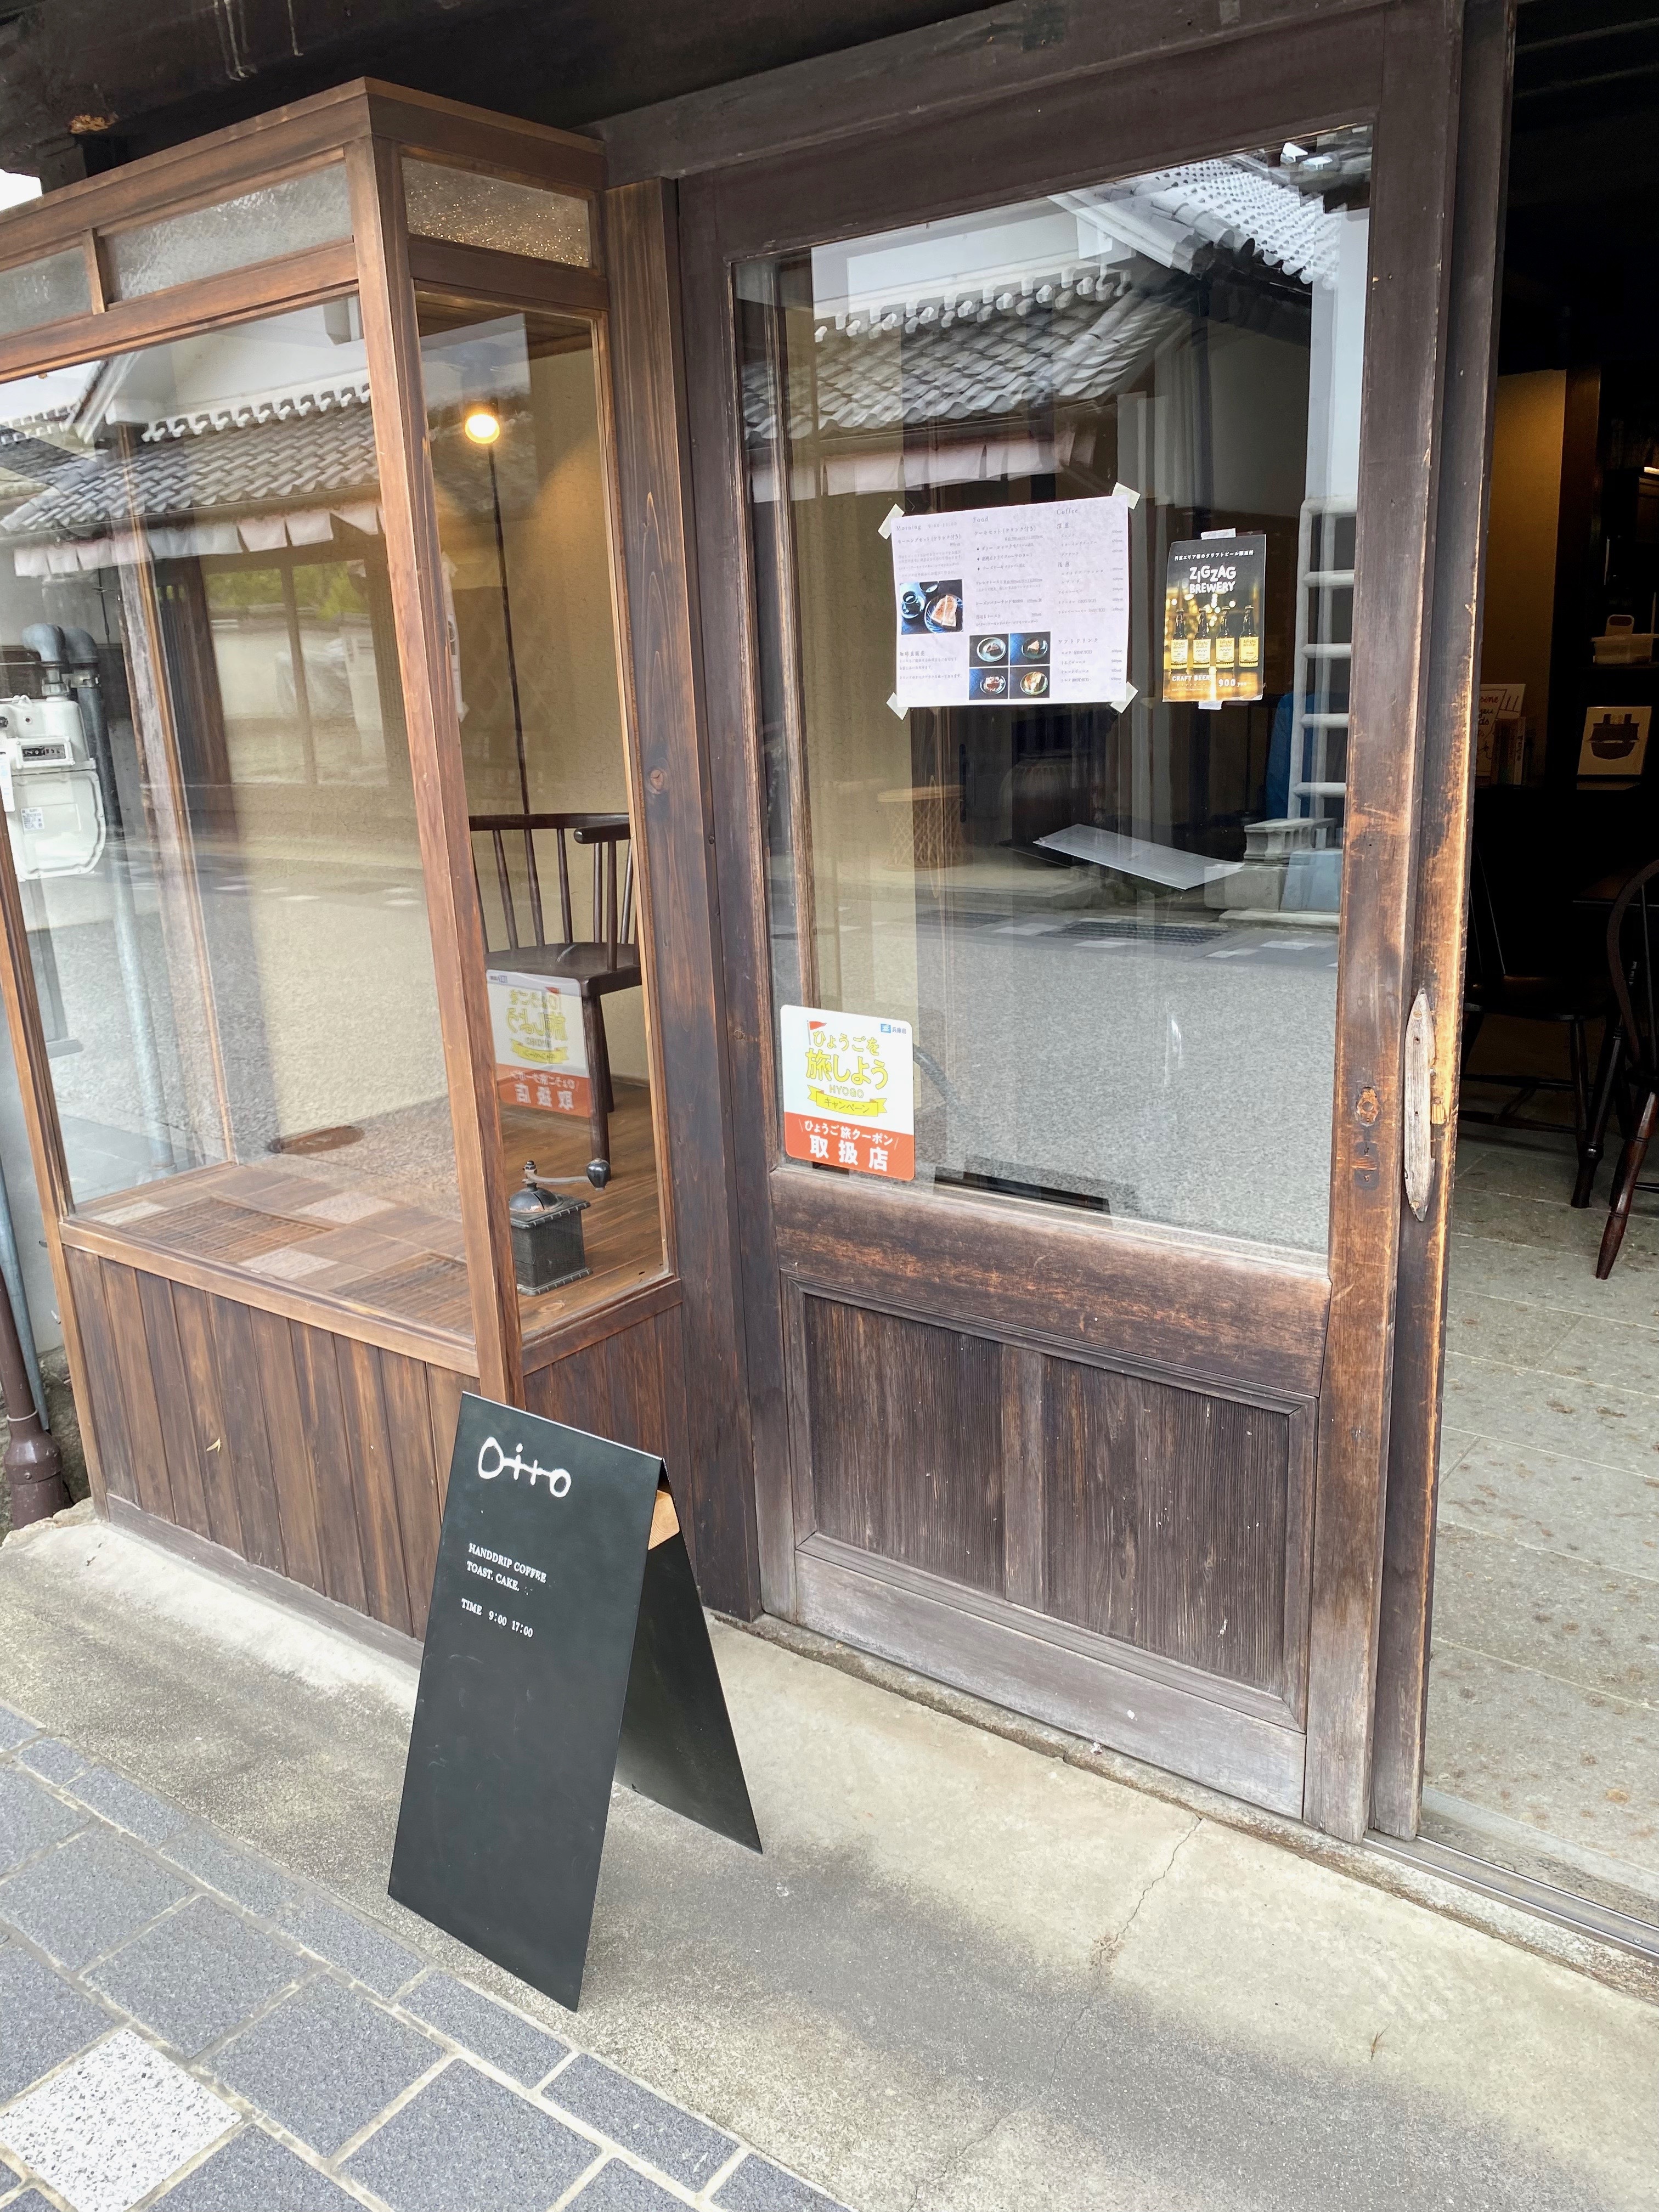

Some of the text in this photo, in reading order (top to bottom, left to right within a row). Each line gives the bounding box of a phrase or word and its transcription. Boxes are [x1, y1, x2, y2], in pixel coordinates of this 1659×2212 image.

[1189, 580, 1236, 594] BREWERY
[1218, 678, 1235, 687] 900
[812, 1030, 880, 1056] ひょうごを
[805, 1048, 888, 1090] 旅しよう
[830, 1084, 864, 1098] HYOGO
[824, 1097, 870, 1114] キャンペーン
[804, 1120, 893, 1146] ひょうご旅クーポン
[810, 1134, 888, 1172] 取扱店
[466, 1560, 520, 1591] TOAST. CAKE.
[469, 1543, 546, 1583] HANDDRIP COFFEE
[461, 1598, 533, 1638] TIME 9:00 17:00
